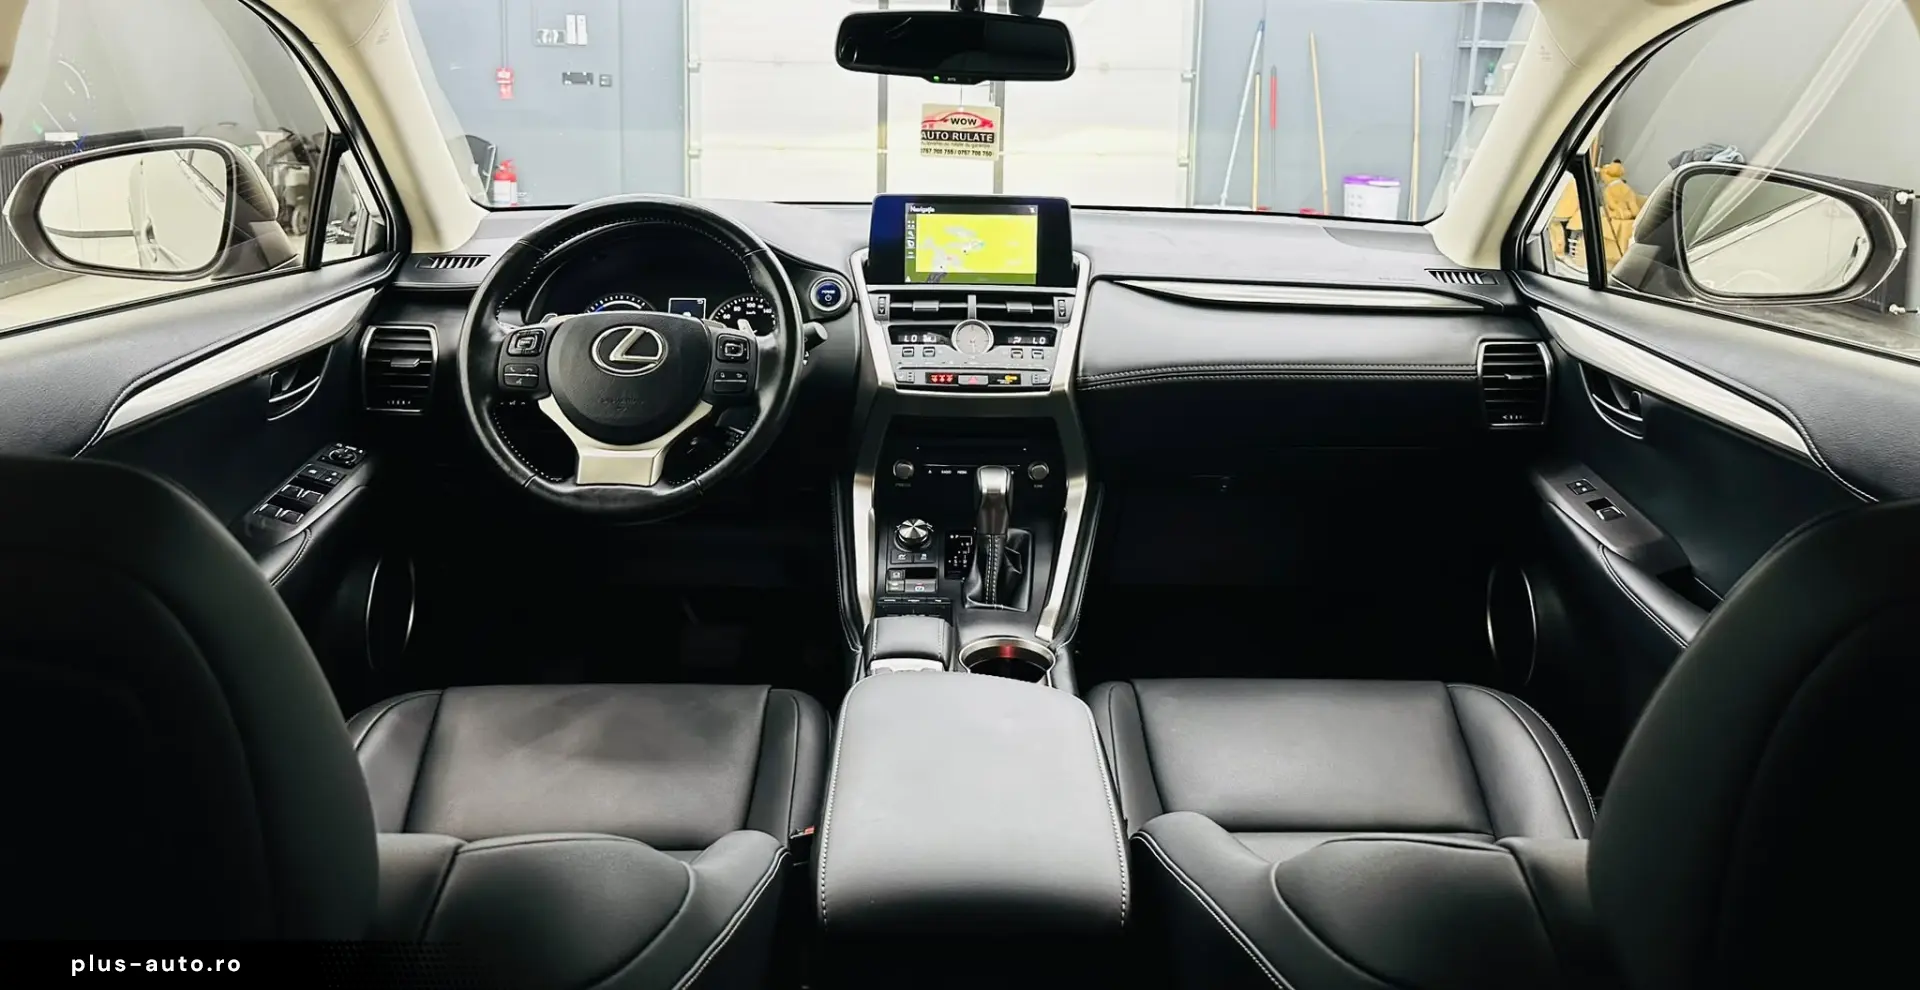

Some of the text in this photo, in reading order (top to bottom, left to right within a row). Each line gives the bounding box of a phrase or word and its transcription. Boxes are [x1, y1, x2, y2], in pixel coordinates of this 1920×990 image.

[950, 117, 977, 126] WOW
[921, 131, 993, 142] AUTO RULATE
